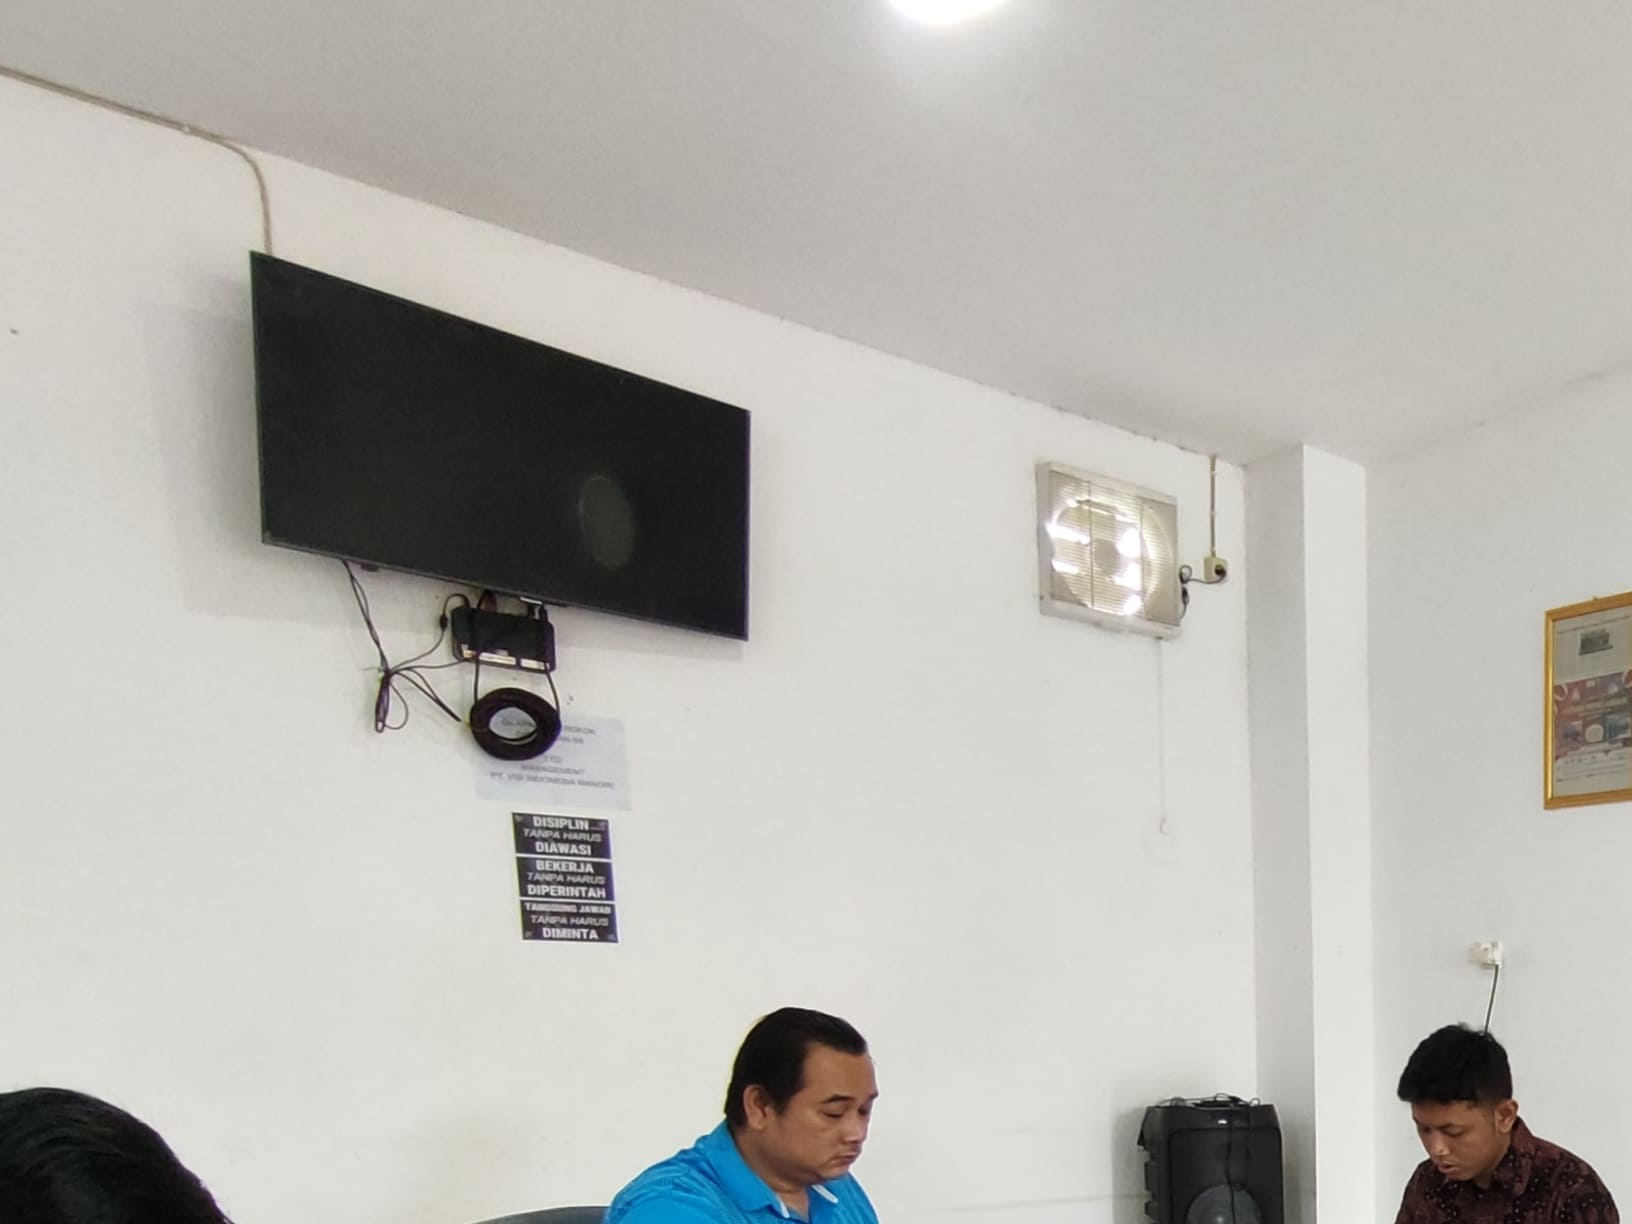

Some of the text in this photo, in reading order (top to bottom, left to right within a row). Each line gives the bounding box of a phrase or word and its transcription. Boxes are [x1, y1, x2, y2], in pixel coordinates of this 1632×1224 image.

[532, 816, 590, 831] DISIPLIN
[523, 828, 602, 843] TANPA HARUS
[535, 841, 592, 856] DIAWASI
[535, 860, 594, 874] BEKERJA
[527, 872, 606, 885] TANPA HARUS
[527, 884, 607, 899] DIPERINTAH
[579, 905, 612, 915] JAWAB
[530, 915, 609, 927] TANPA HARUS
[542, 927, 599, 941] DIMINTA
